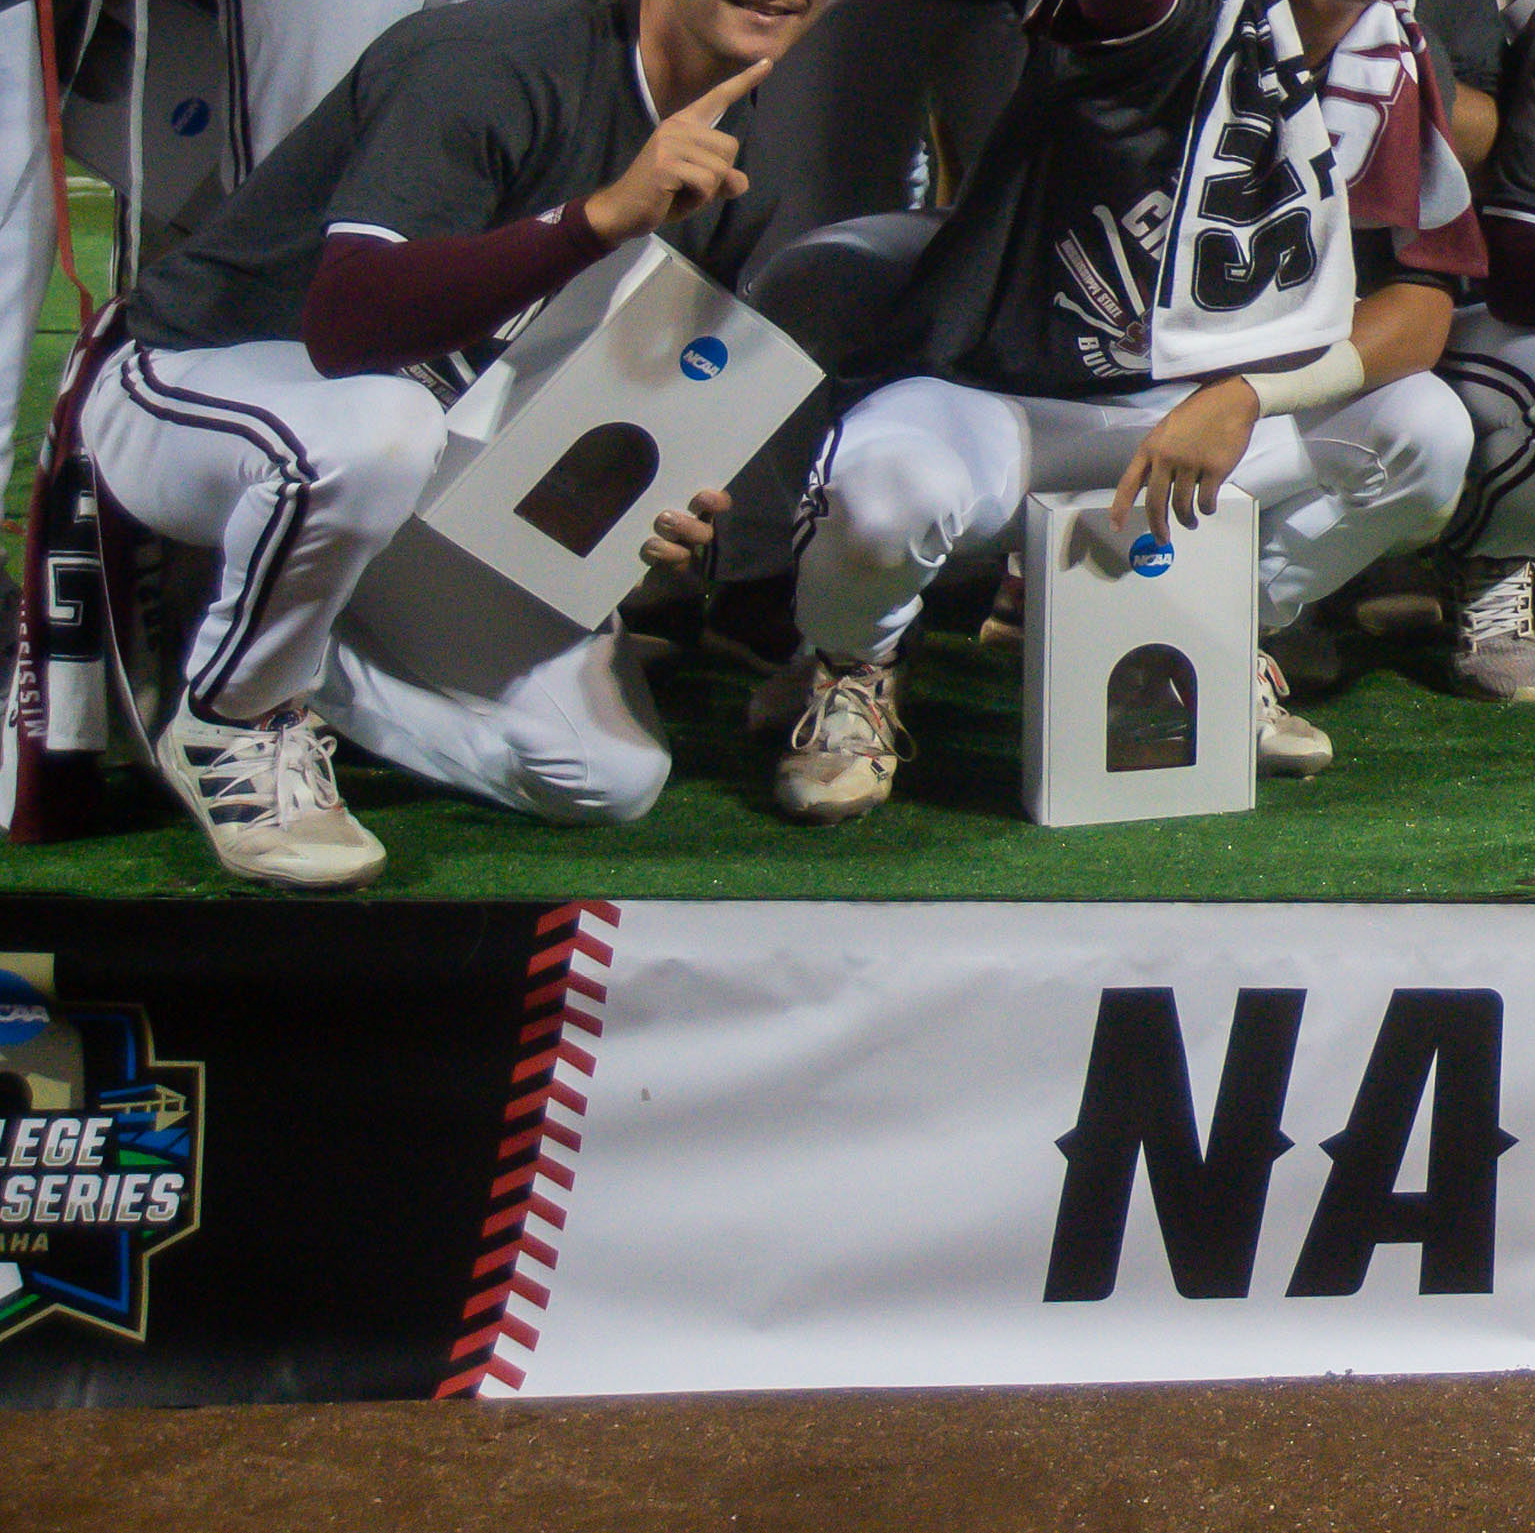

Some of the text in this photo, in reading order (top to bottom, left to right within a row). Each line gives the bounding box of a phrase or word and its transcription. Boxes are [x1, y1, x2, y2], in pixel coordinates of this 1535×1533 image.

[683, 350, 721, 377] NCAA
[1132, 550, 1173, 568] NCAA
[1, 1173, 184, 1222] SERIES
